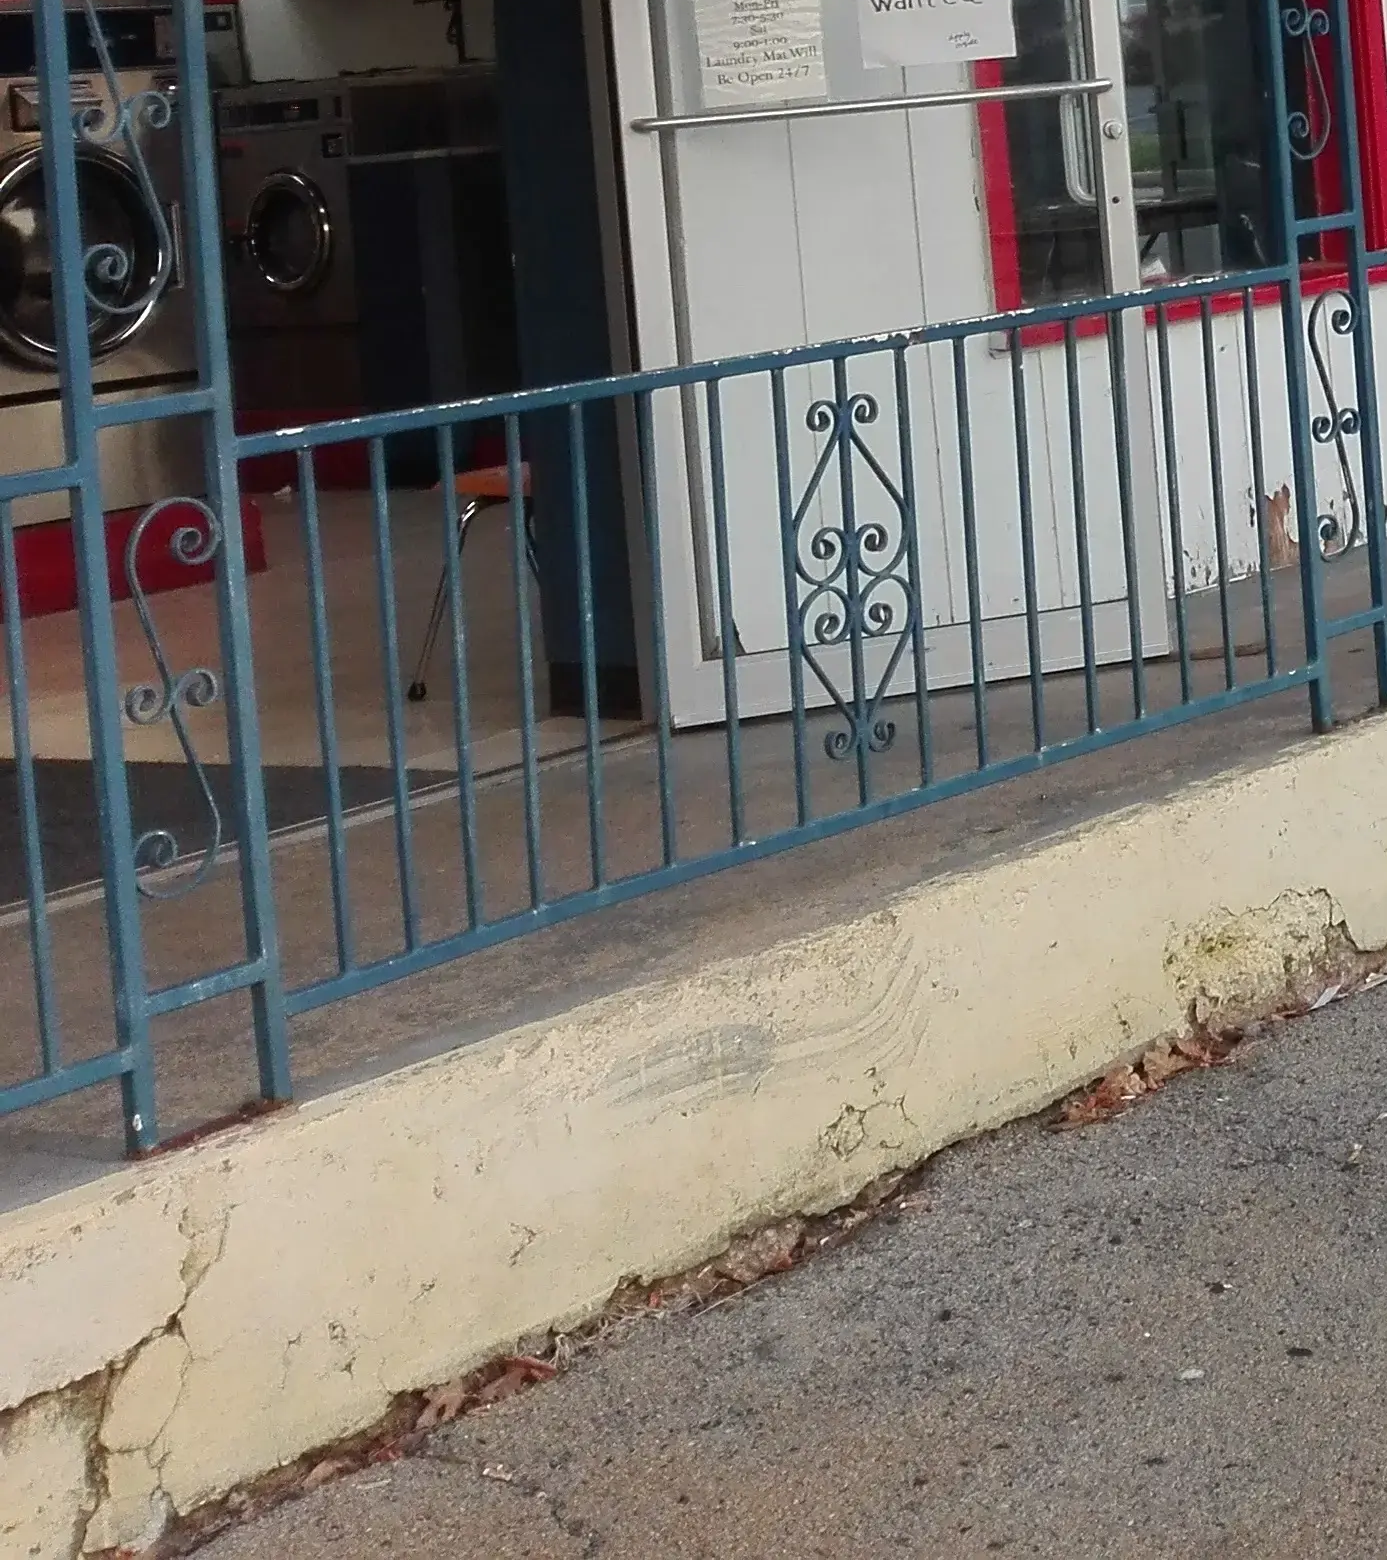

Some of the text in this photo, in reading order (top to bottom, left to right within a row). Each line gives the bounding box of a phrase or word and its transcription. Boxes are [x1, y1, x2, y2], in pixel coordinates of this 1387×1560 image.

[706, 45, 818, 67] Laundry Mat Will
[718, 65, 810, 85] Be Open 24/7
